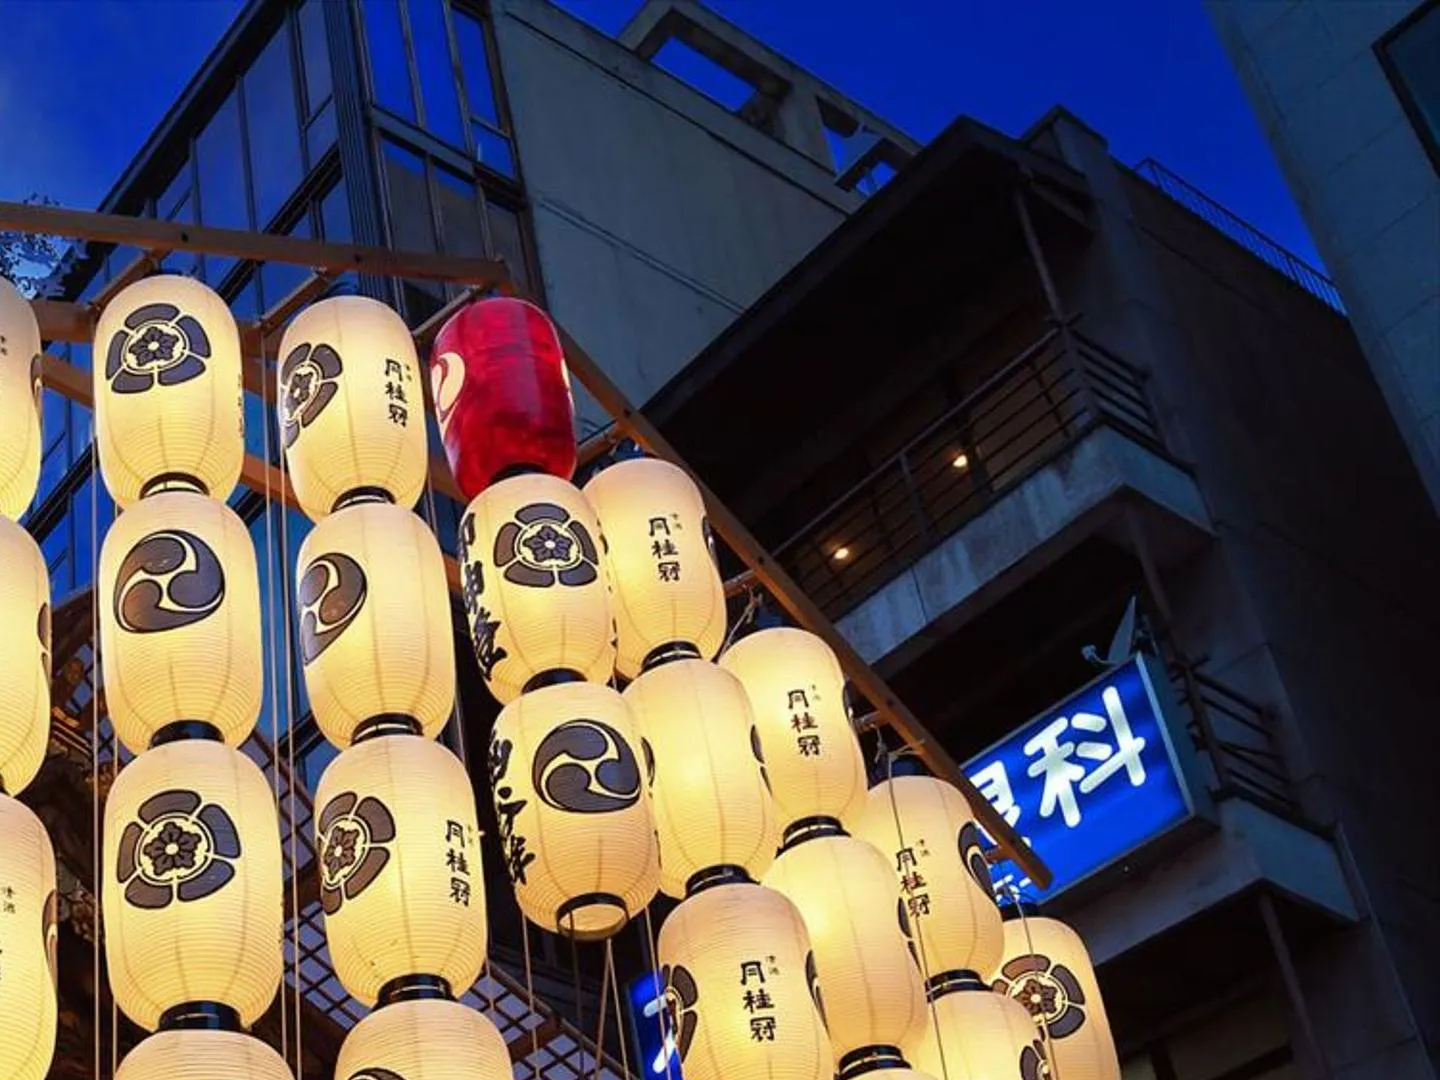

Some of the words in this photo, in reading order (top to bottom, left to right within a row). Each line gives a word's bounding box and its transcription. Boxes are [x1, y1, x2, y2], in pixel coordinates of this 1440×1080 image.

[649, 517, 680, 582] 月桂冠
[788, 688, 820, 757] 月桂冠
[446, 820, 470, 907] 月桂冠
[740, 961, 776, 1041] 月桂冠
